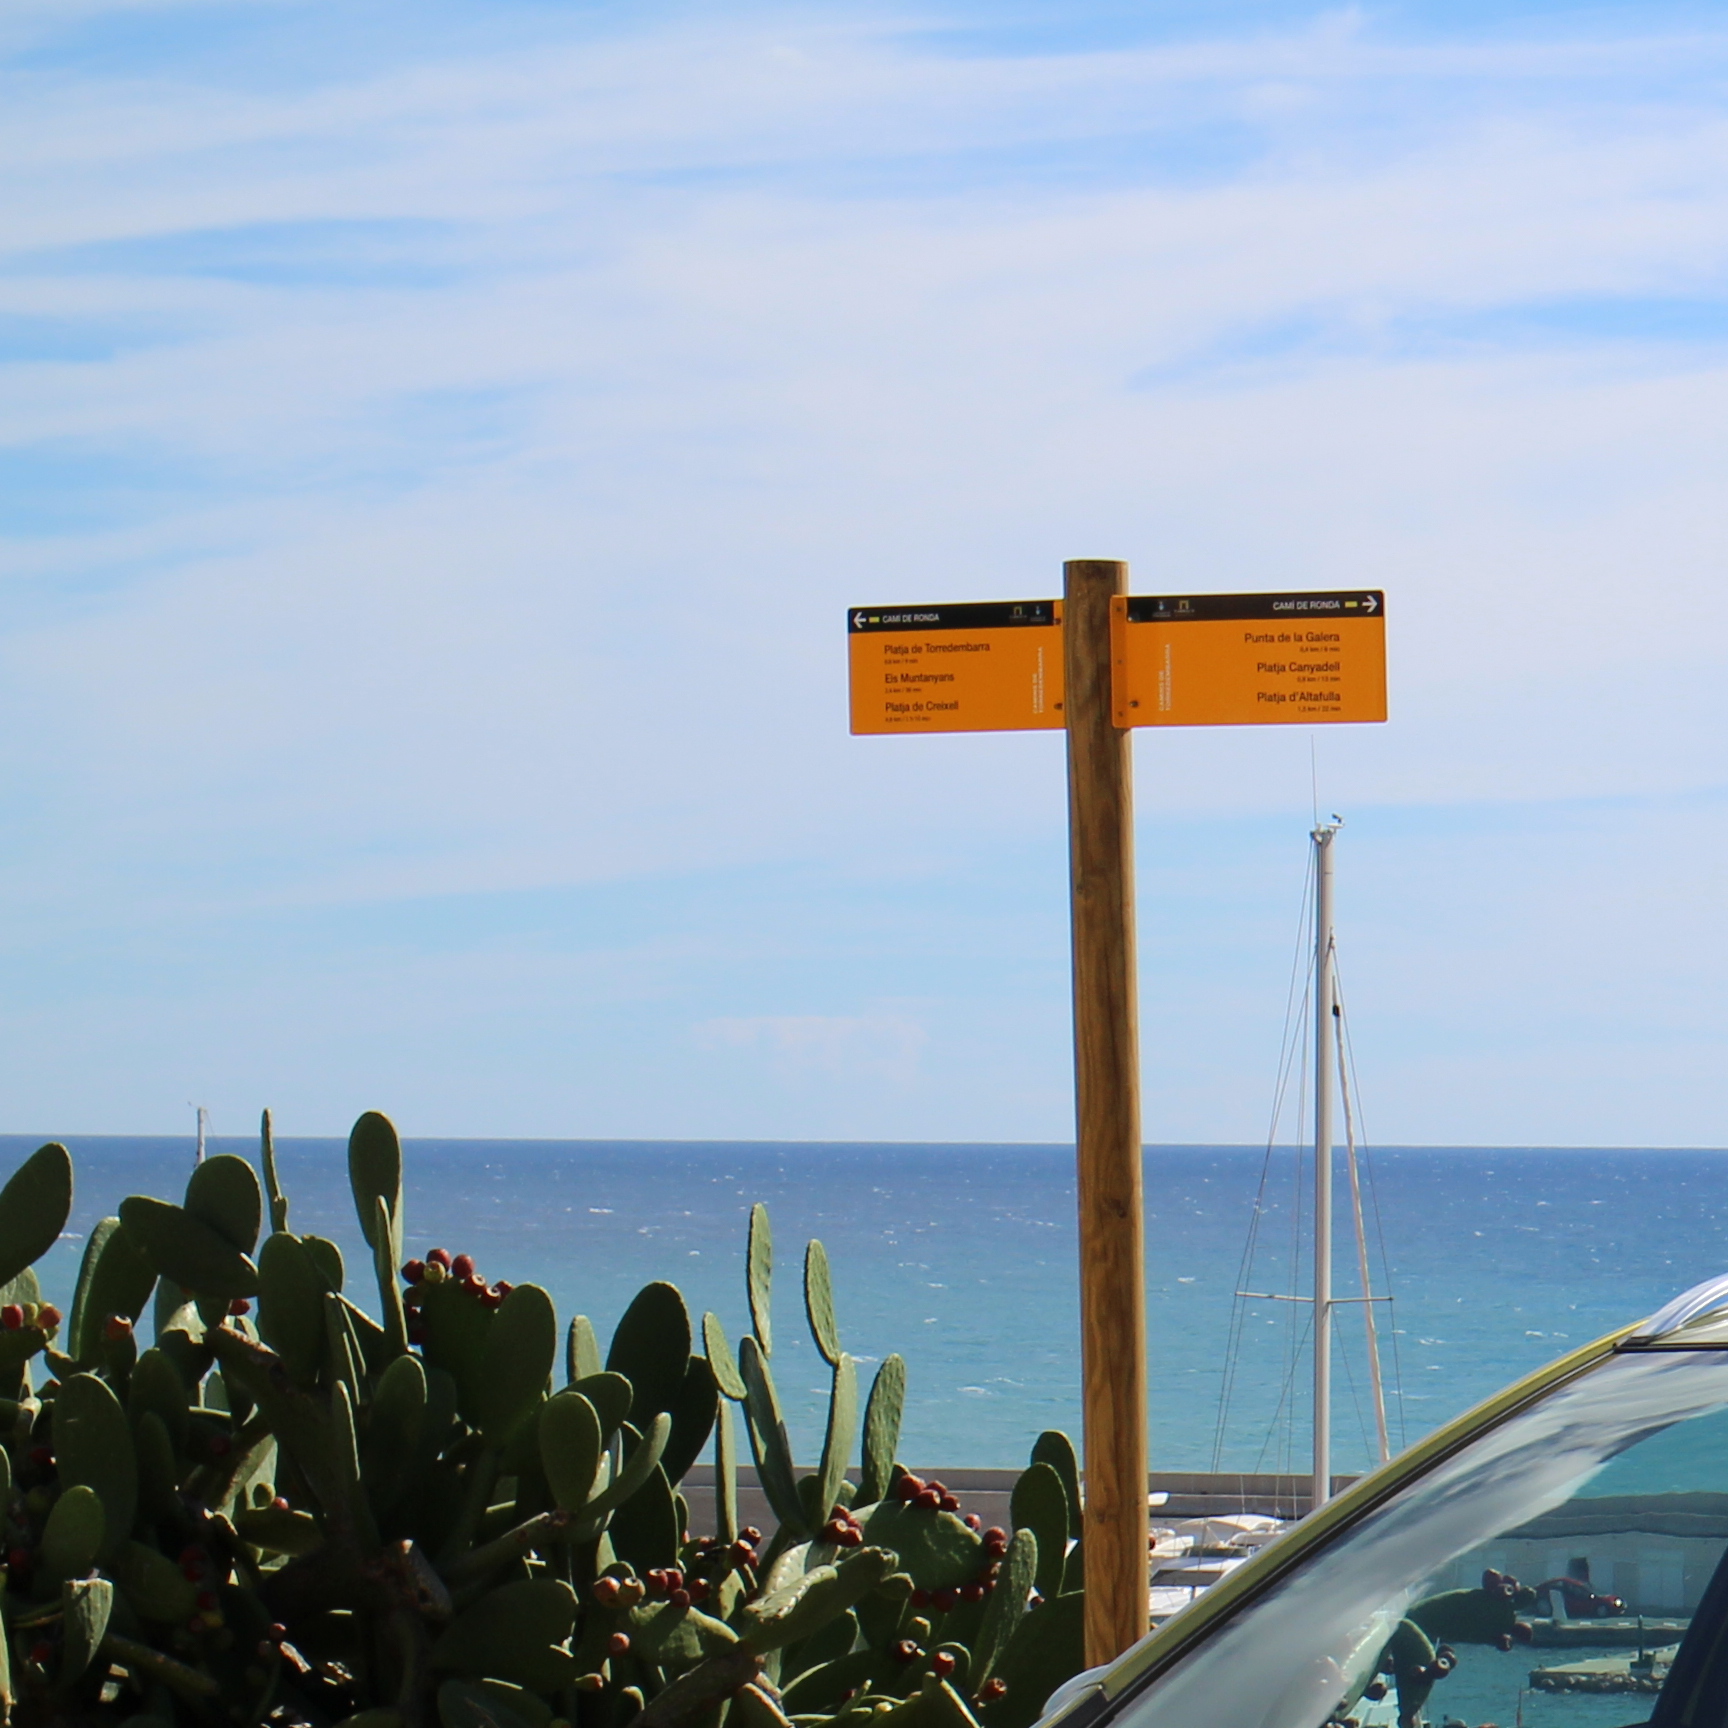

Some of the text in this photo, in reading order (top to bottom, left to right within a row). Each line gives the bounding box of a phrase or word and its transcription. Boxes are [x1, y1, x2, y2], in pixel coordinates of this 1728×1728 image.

[1296, 600, 1308, 609] DE
[1309, 600, 1340, 609] RONDA
[902, 614, 912, 622] DE
[914, 613, 939, 622] RONDA
[1245, 631, 1340, 643] Punta de la Galera
[884, 642, 990, 655] Platja de Torredembarra
[1257, 661, 1340, 674] Platja Canyadell
[900, 673, 954, 684] Muntanyans
[1257, 692, 1286, 704] Platja
[885, 700, 959, 713] Platja de Creixell
